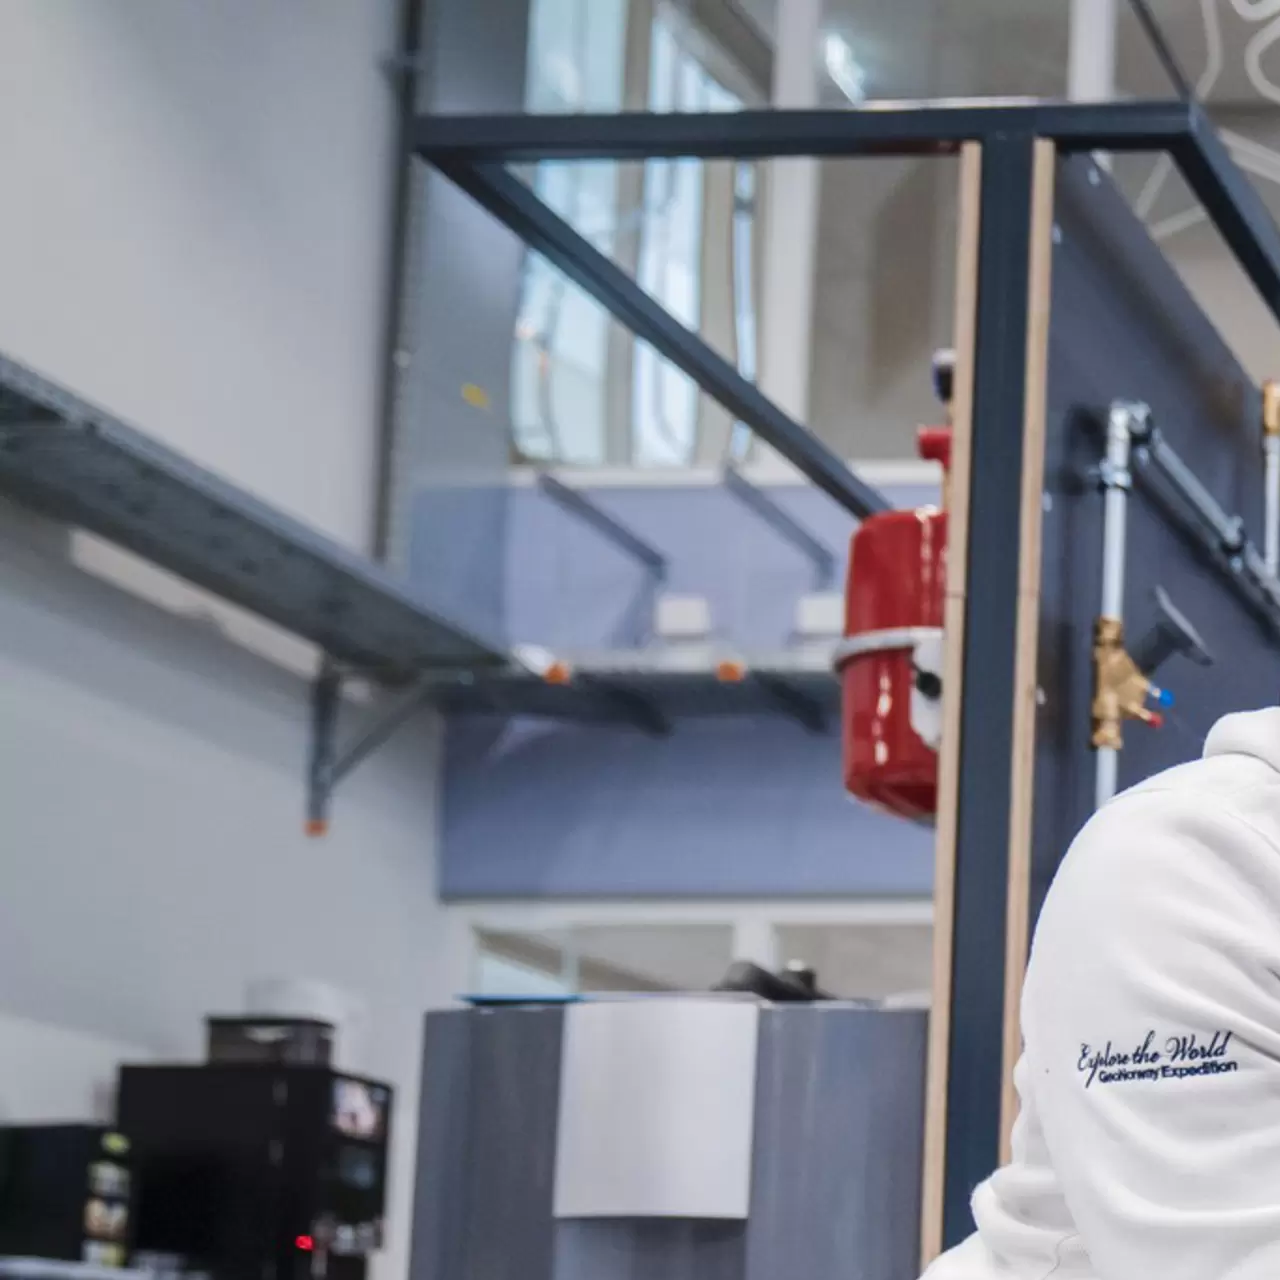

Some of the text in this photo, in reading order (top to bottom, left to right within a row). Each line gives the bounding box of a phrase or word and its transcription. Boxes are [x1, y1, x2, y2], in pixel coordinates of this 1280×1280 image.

[1077, 1029, 1234, 1089] Explore the World
[1161, 1059, 1238, 1079] Expedition
